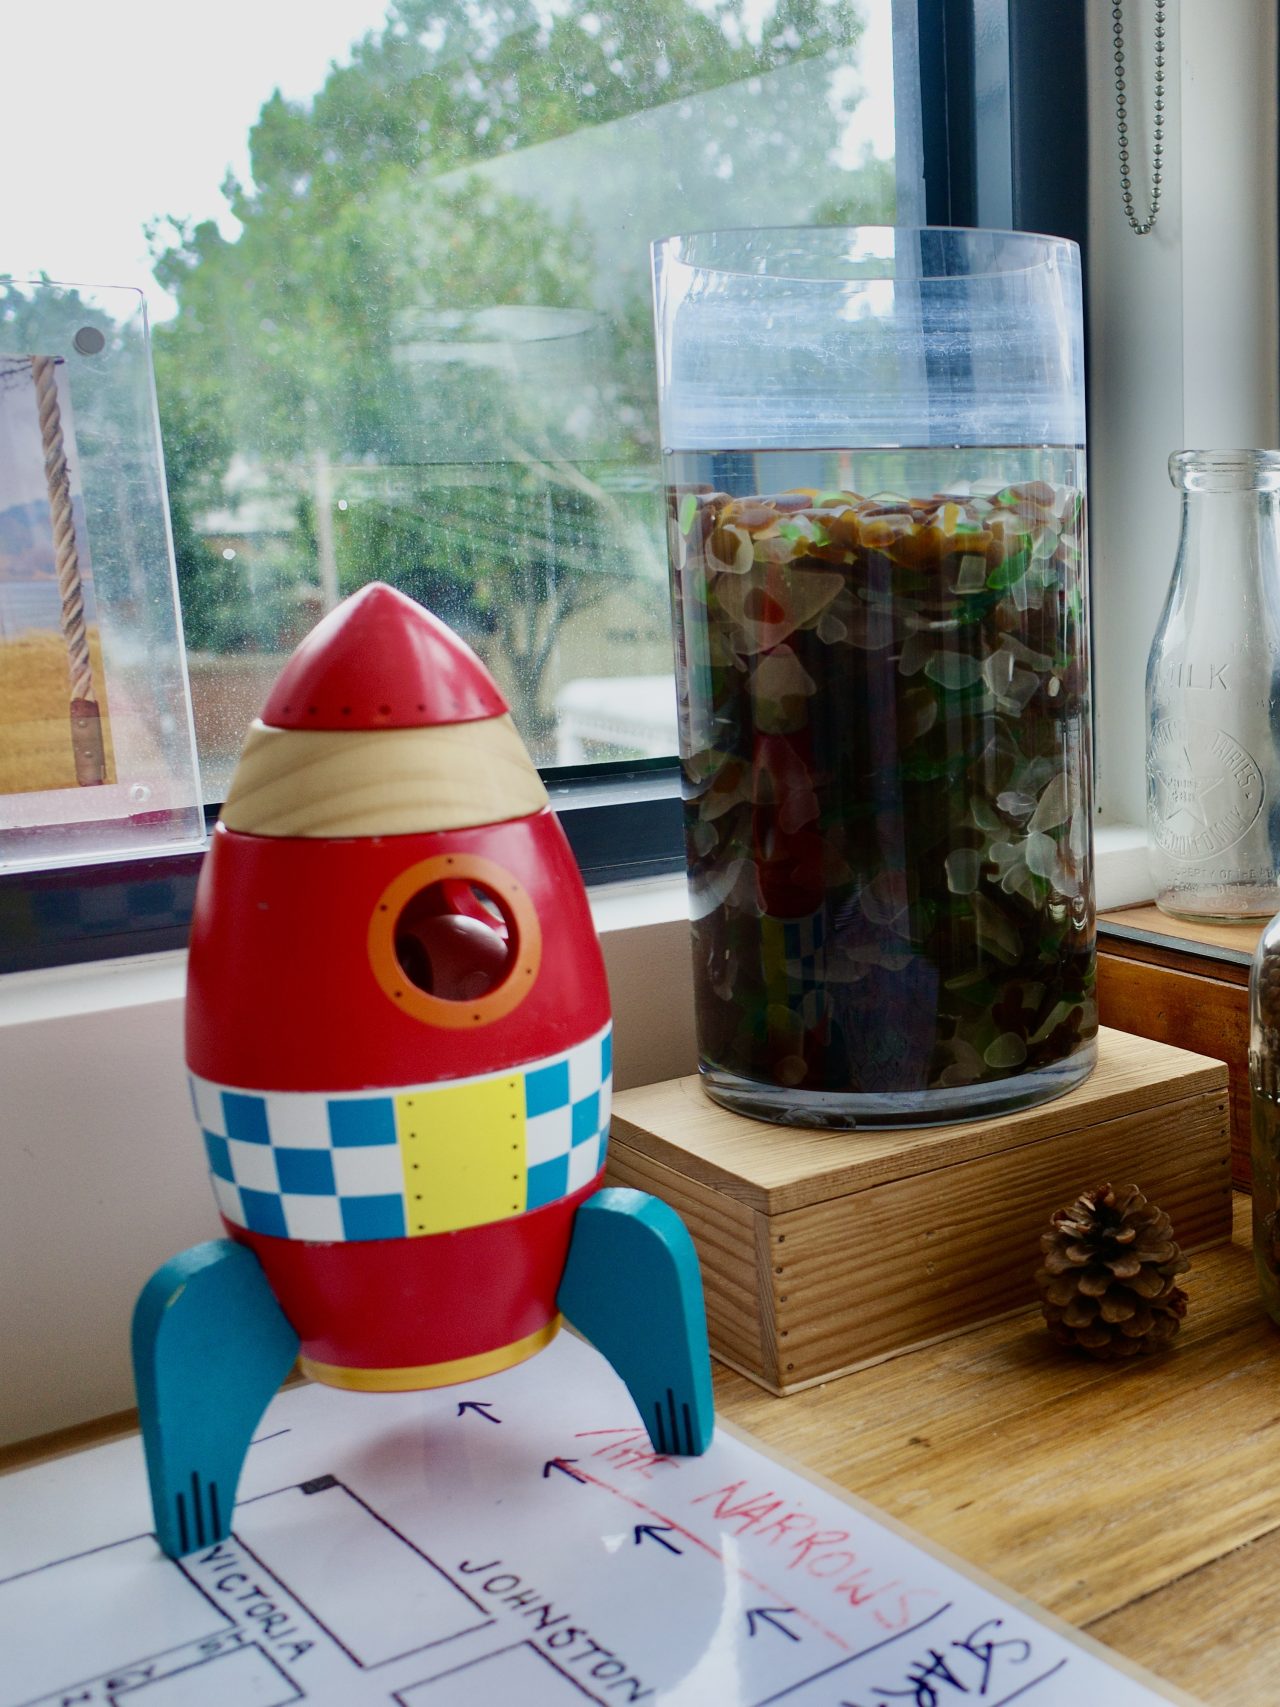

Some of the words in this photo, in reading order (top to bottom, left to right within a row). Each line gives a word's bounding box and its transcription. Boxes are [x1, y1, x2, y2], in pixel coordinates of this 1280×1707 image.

[199, 1545, 316, 1664] VICTORIA
[690, 1480, 942, 1632] NARROWS
[458, 1559, 656, 1704] JOHNSTON
